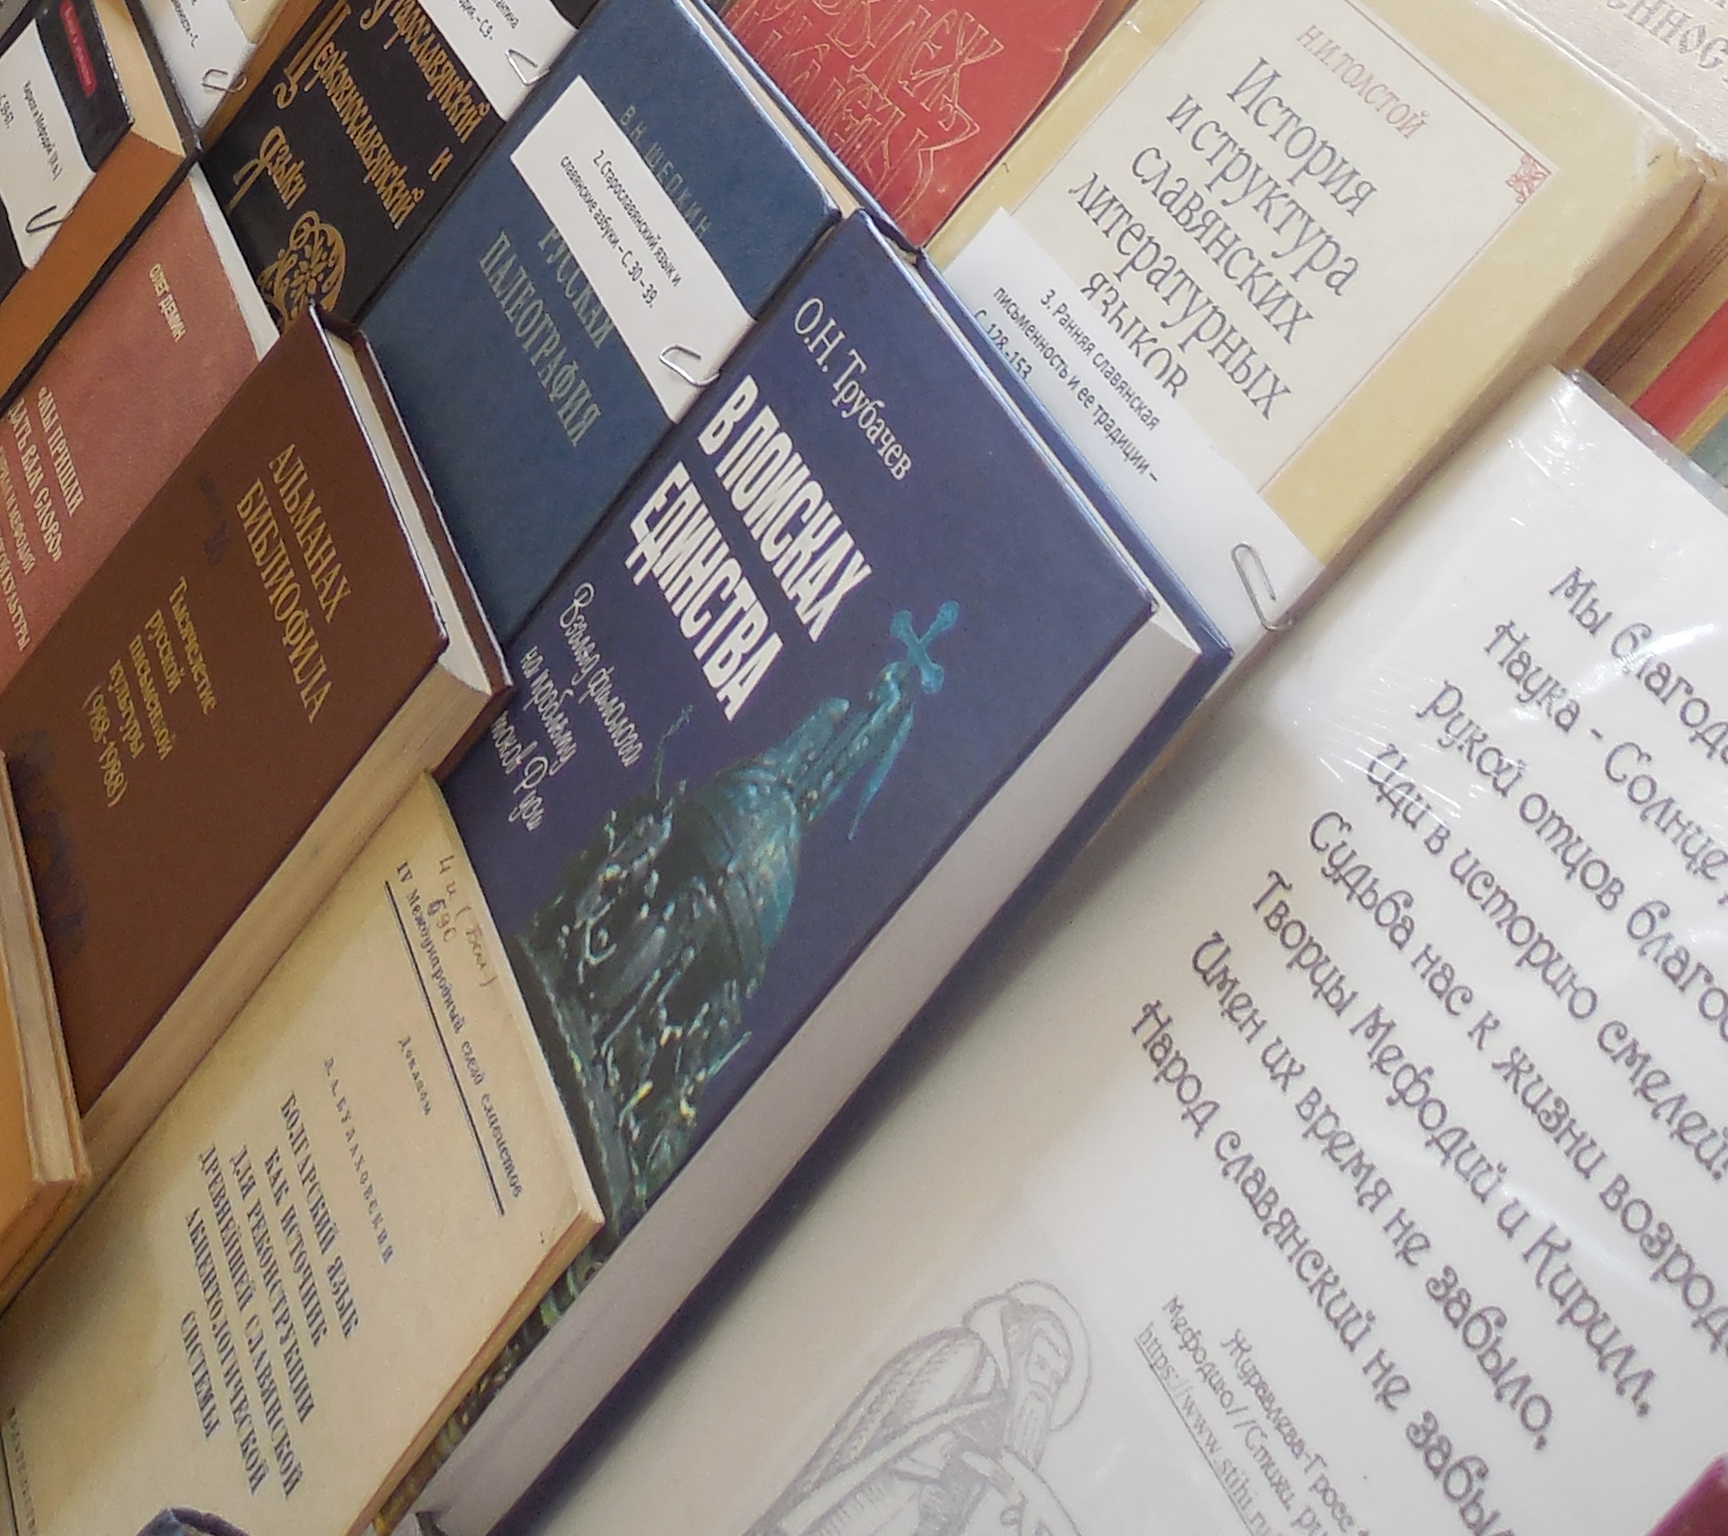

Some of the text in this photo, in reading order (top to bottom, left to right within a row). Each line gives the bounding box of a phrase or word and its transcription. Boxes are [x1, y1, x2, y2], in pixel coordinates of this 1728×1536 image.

[425, 146, 455, 182] и
[1225, 53, 1380, 218] История
[1295, 21, 1432, 143] Н.И.ТОЛСТОЙ
[558, 152, 598, 215] славянские
[592, 206, 621, 251] азбуки
[598, 158, 661, 251] Старославянский
[652, 243, 678, 280] язык
[1127, 140, 1314, 347] славянских
[1165, 91, 1364, 298] и структура
[157, 292, 186, 343] ДЕМИН
[478, 230, 603, 448] ПАЛЕОГРАФИЯ
[788, 292, 917, 484] О.Н. Трубачев
[991, 284, 1075, 383] письменность
[1089, 402, 1154, 476] традиции
[1051, 299, 1100, 358] Ранняя
[1089, 347, 1163, 433] славянская
[1066, 166, 1293, 422] литературных
[6, 396, 66, 563] ДАТЬ ВАМ СЛОВО»
[34, 381, 85, 518] «МЫ ПРИШЛИ
[268, 435, 351, 625] АЛЬМАНАХ
[694, 373, 874, 643] В ПОИСКАХ
[143, 606, 186, 695] русской
[165, 575, 217, 718] Тысячелетие
[234, 476, 336, 725] БИБЛИОФИЛА
[557, 579, 645, 770] Взгляд филолога
[626, 459, 790, 723] ЕДИНСТВА
[1481, 612, 1586, 739] Наука
[1547, 557, 1611, 641] Мы
[80, 682, 130, 812] (988-1988)
[108, 657, 146, 761] культуры
[127, 634, 176, 762] письменной
[510, 750, 547, 836] Руси
[518, 644, 579, 777] на проблему
[1416, 673, 1629, 919] Рукой отцов
[1299, 801, 1607, 1186] Судьба нас к жизни
[1423, 817, 1453, 860] в
[1445, 844, 1602, 1028] историю
[397, 1029, 433, 1119] Доклады
[403, 885, 466, 1037] Международный
[477, 1089, 524, 1202] славистов
[1188, 927, 1432, 1274] Имен их время не
[1248, 865, 1527, 1241] Творцы Мефодий и
[228, 1140, 316, 1426] ДЛЯ РЕКОНСТРУКЦИИ
[262, 1145, 329, 1351] КАК ИСТОЧНИК
[277, 1089, 361, 1342] БОЛГАРСКИЙ ЯЗЫК
[1124, 995, 1414, 1415] Народ славянский не
[178, 1304, 222, 1442] СИСТЕМЫ
[182, 1200, 271, 1498] АКЦЕНТОЛОГИЧЕСКОЙ
[197, 1137, 305, 1502] ДРЕВНЕЙШЕЙ СЛАВЯНСКОЙ
